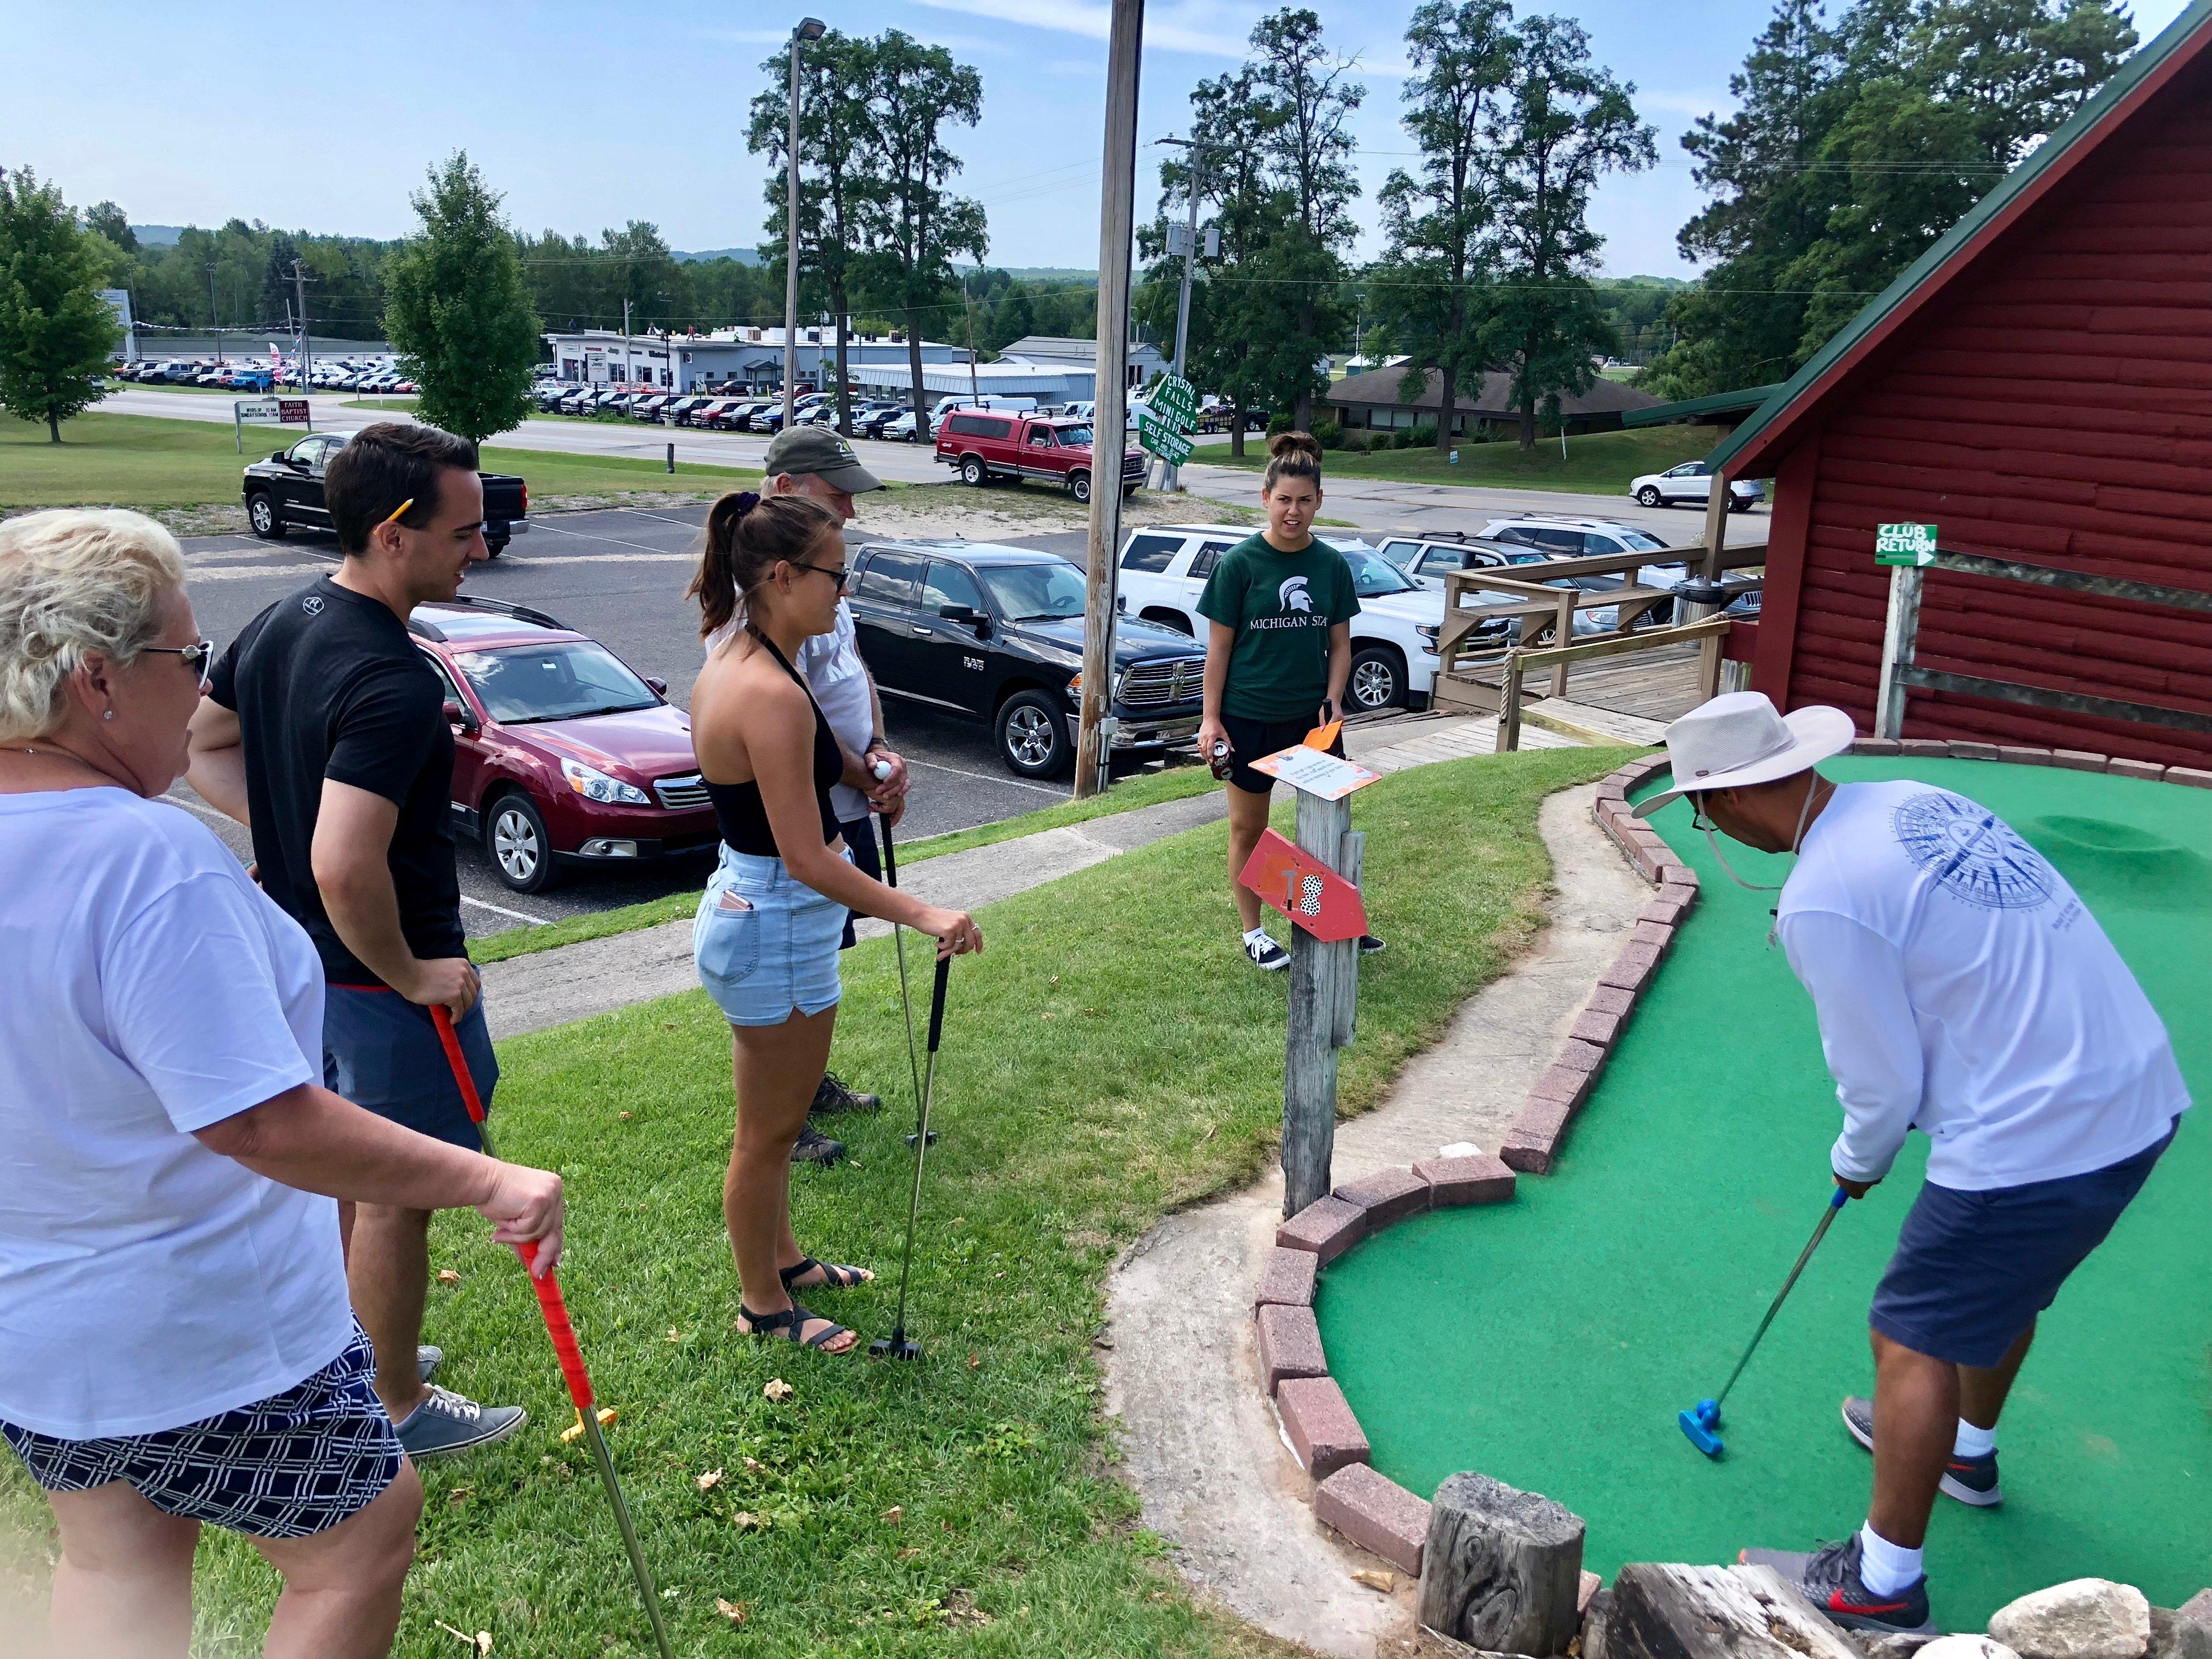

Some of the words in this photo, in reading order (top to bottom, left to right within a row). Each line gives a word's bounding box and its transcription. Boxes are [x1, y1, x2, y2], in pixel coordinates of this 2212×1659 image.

[1167, 375, 1195, 400] CRYSTAL
[1165, 386, 1193, 412] FALLS
[1154, 398, 1175, 419] MINI
[1175, 411, 1196, 431] GOLF
[1143, 421, 1163, 438] SELF
[1161, 432, 1190, 456] STORAGE
[1150, 437, 1159, 446] CAR
[1155, 446, 1172, 461] STORAGE
[1879, 524, 1927, 540] CLUB
[1876, 537, 1936, 552] RETURN
[1250, 616, 1307, 630] MICHIGAN
[1312, 615, 1328, 627] STA
[963, 656, 985, 666] RAM
[963, 661, 984, 671] 1500
